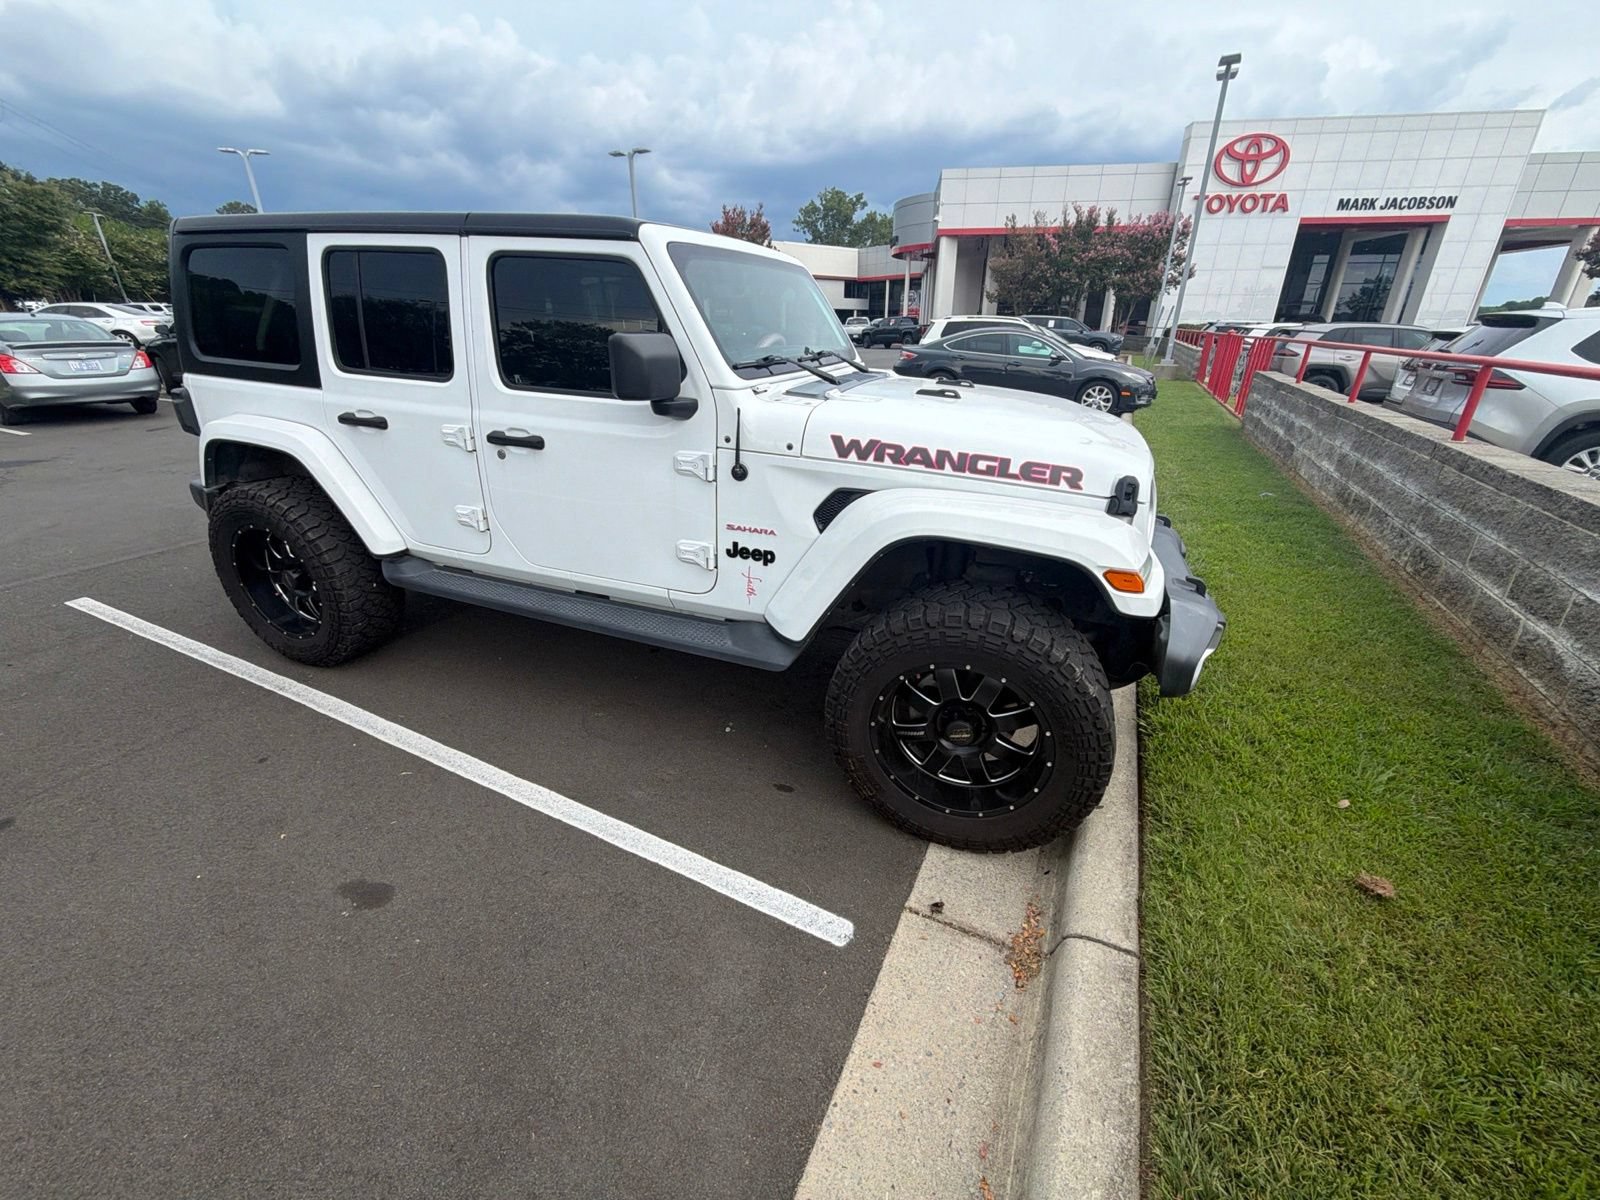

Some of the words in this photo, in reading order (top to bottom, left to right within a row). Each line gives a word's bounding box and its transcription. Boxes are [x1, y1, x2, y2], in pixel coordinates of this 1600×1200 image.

[1336, 197, 1379, 211] MARK
[1380, 195, 1458, 211] JACOBSON
[830, 434, 1084, 491] WRANGLER
[726, 523, 777, 537] SAHARA
[725, 541, 776, 567] Jeep
